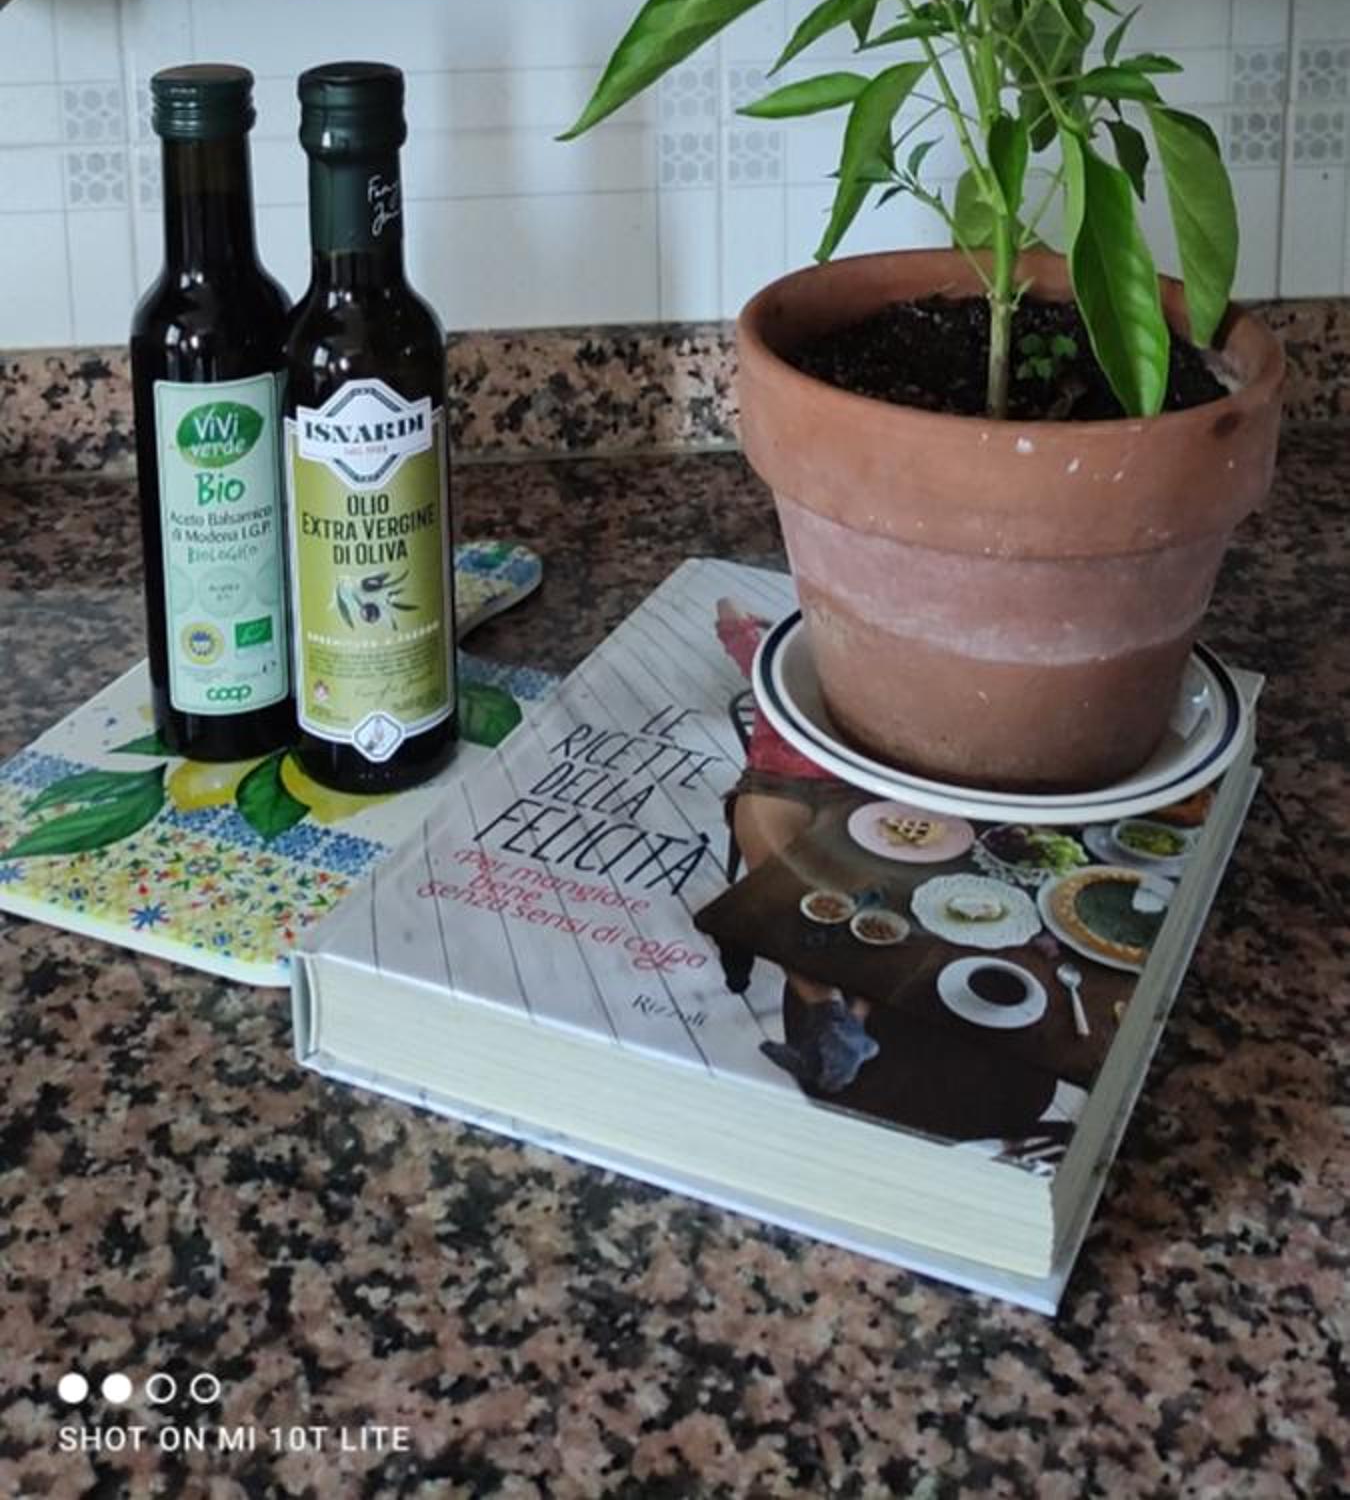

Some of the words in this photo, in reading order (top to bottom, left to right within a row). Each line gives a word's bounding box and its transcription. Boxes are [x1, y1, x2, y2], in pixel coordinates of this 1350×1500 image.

[192, 436, 246, 457] verde
[305, 414, 424, 444] ISNARDI
[194, 472, 246, 507] Bio
[347, 494, 389, 517] OLIO
[170, 511, 204, 527] Aceto
[208, 504, 273, 526] Balsamico
[302, 512, 358, 541] EXTRA
[363, 502, 435, 540] VERGINE
[185, 528, 239, 544] Modena
[333, 546, 350, 565] DI
[355, 540, 408, 566] OLIVA
[641, 703, 704, 742] LE
[550, 723, 723, 791] RICETTE
[530, 761, 657, 821] DELLA
[473, 798, 711, 896] FELICITÀ
[468, 871, 543, 904] bene
[508, 866, 652, 916] mangiare
[416, 879, 507, 913] senza
[506, 900, 588, 935] sensi
[591, 922, 623, 945] di
[623, 935, 709, 975] colpa
